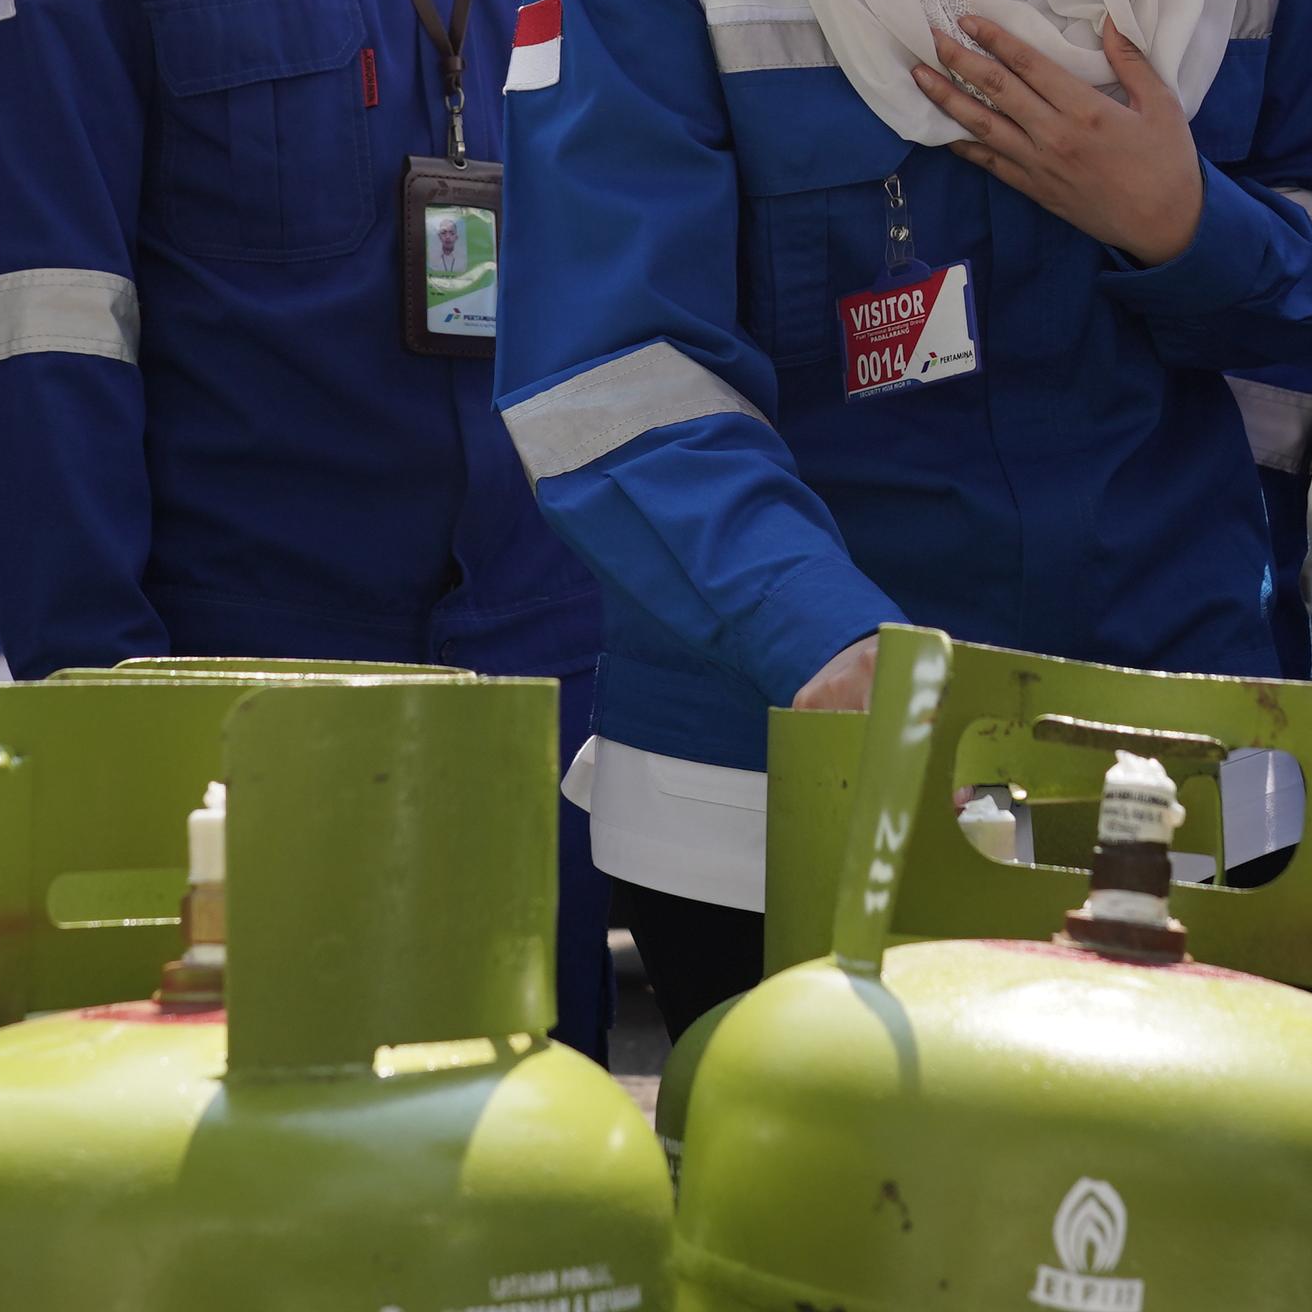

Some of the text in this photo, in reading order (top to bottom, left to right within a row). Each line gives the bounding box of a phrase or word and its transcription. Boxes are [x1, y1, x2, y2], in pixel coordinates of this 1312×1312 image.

[850, 289, 925, 331] VISITOR
[870, 327, 910, 343] PADALARANG
[857, 343, 907, 386] 0014
[939, 349, 973, 365] PERTAMINA
